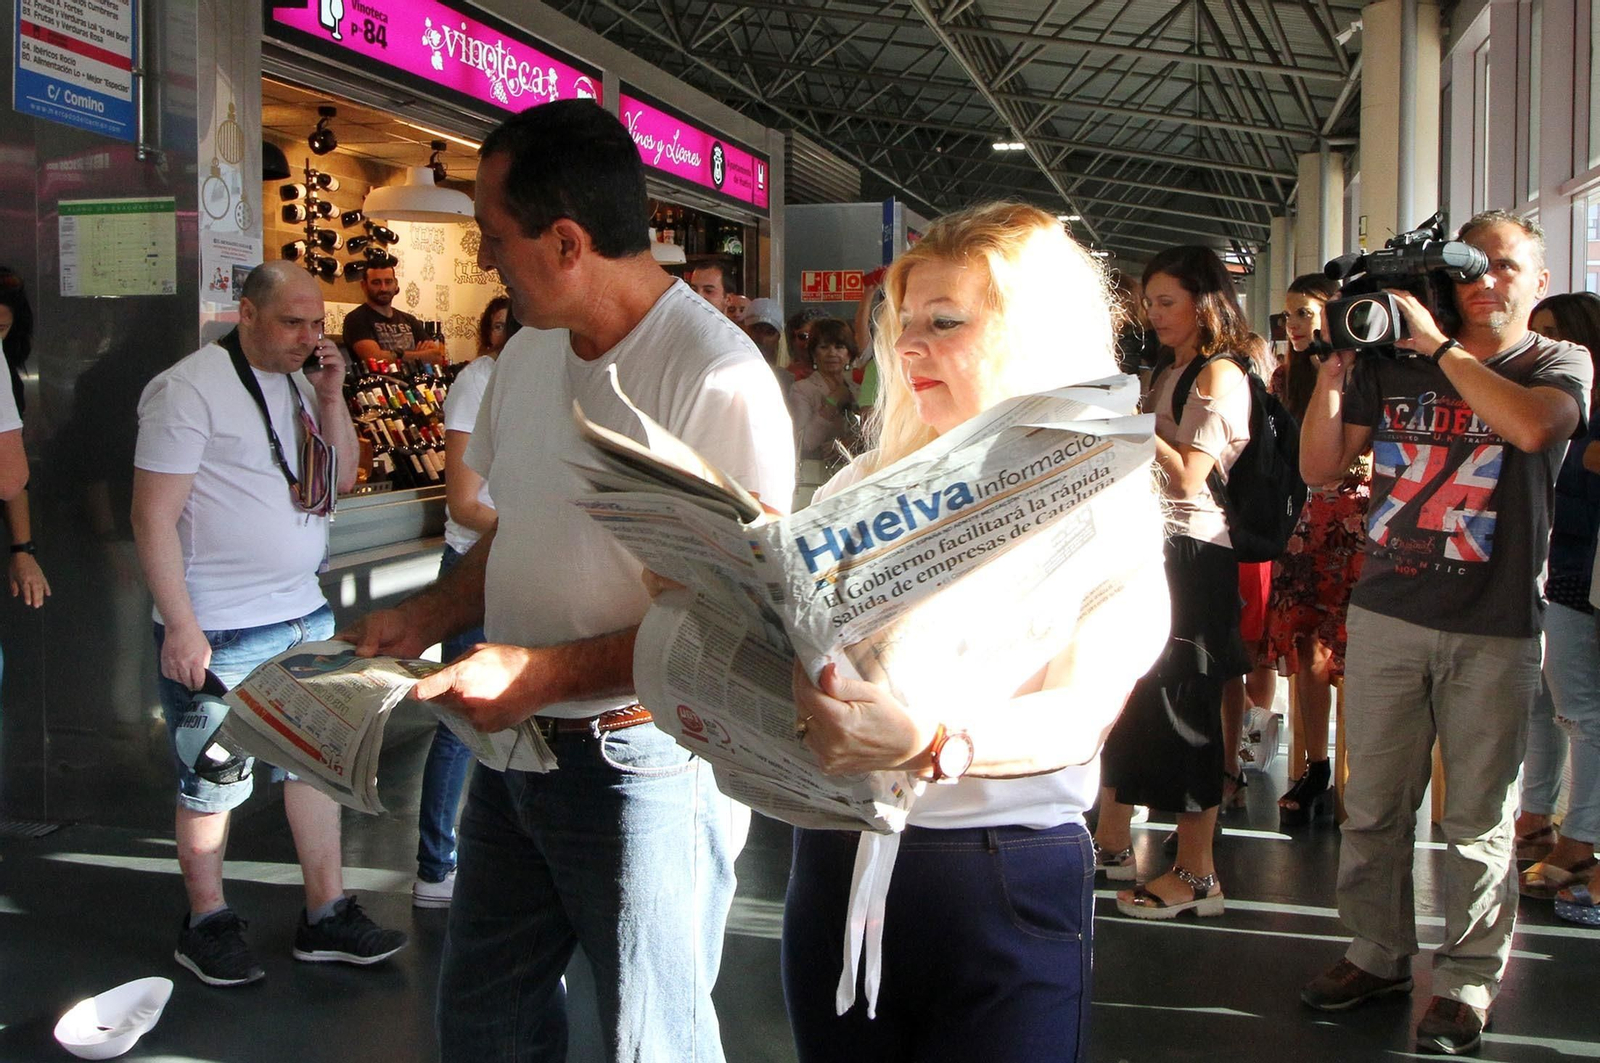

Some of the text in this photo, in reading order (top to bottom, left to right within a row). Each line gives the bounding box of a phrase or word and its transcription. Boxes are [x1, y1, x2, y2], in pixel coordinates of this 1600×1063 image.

[34, 10, 54, 25] Frutas
[62, 20, 89, 38] Verduras
[351, 0, 388, 23] Vinoteca
[47, 84, 105, 113] C/ Comino
[625, 111, 702, 167] Vinos y Licores
[1378, 403, 1492, 435] ACADEM
[795, 480, 975, 575] Huelva
[975, 434, 1102, 500] Informacio
[822, 583, 844, 611] El
[846, 547, 937, 602] Gobierno
[939, 503, 1026, 553] facilitará
[1029, 491, 1048, 514] la
[1050, 466, 1111, 503] rápida
[831, 589, 889, 629] salida
[891, 577, 914, 600] de
[916, 534, 1006, 586] empresas
[1010, 520, 1032, 541] de
[1035, 475, 1117, 527] Cataluña
